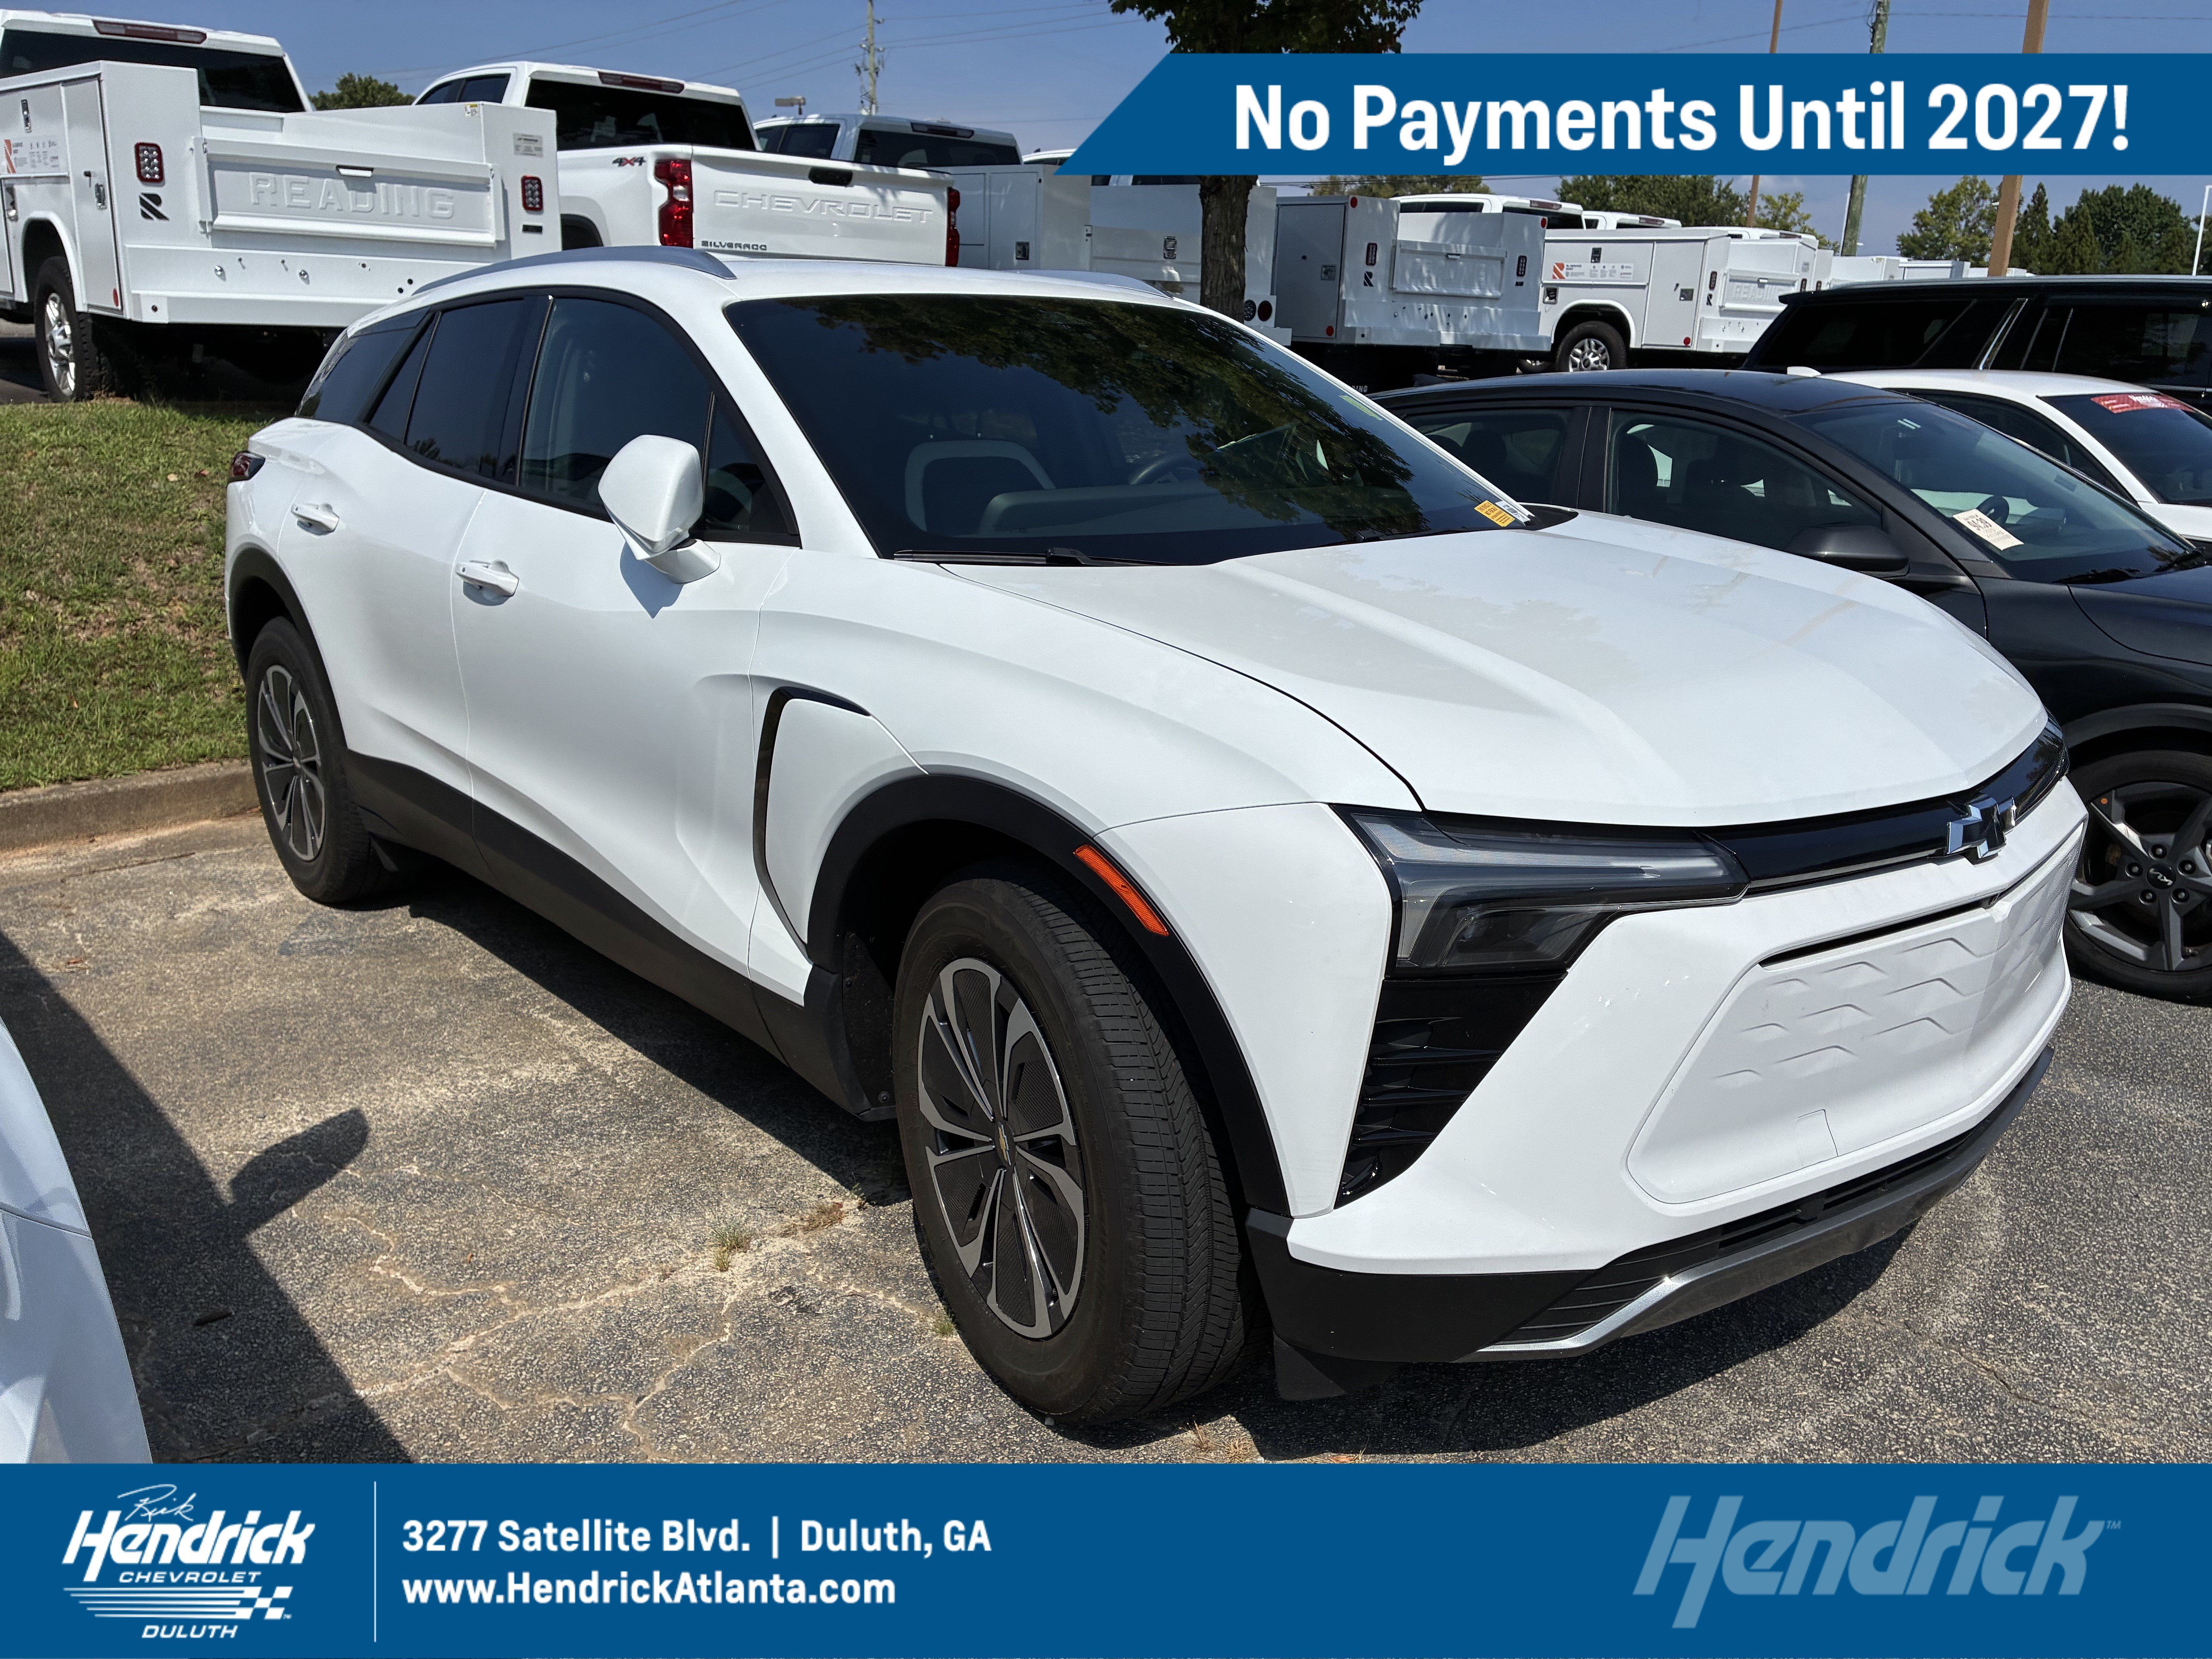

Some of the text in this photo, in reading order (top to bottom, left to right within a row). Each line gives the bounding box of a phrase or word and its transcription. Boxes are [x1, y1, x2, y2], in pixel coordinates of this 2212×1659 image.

[248, 171, 455, 219] READING
[714, 190, 933, 223] CHEVROLET
[701, 240, 767, 251] SILVERADO
